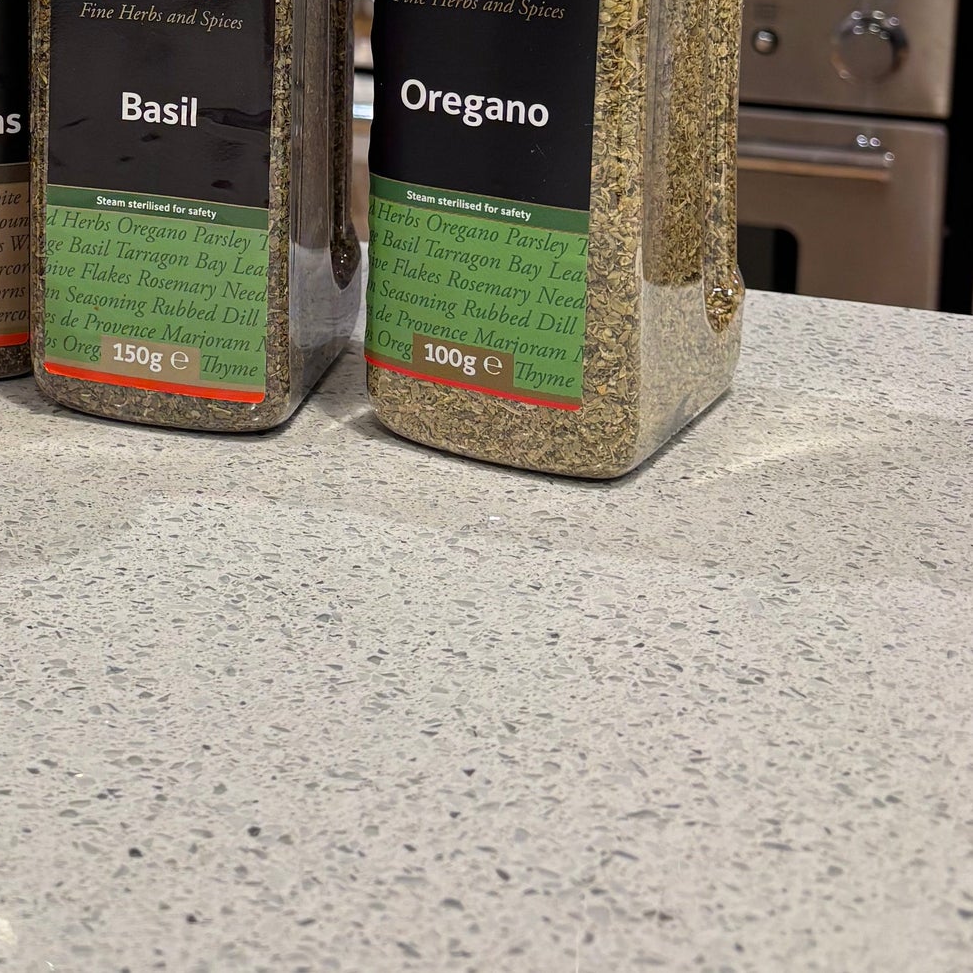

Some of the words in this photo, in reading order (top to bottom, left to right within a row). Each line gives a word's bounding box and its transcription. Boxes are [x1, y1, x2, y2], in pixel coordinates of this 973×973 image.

[79, 2, 114, 19] Fine
[119, 4, 163, 22] Herbs
[167, 9, 197, 25] and
[200, 11, 243, 32] Spices
[121, 91, 198, 127] Basil
[401, 79, 549, 127] Oregano
[96, 196, 125, 208] Steam
[127, 200, 170, 213] sterilised
[173, 204, 185, 214] for
[188, 205, 216, 220] safety
[407, 190, 435, 203] Steam
[438, 197, 481, 211] sterilised
[484, 201, 498, 213] for
[501, 206, 531, 221] safety
[62, 213, 111, 232] Herbs
[117, 217, 187, 242] Oregano
[193, 227, 251, 254] Parsley
[377, 205, 420, 227] Herbs
[427, 214, 499, 242] Oregano
[505, 227, 569, 258] Parsley
[69, 237, 110, 257] Basil
[117, 241, 189, 269] Tarragon
[196, 252, 227, 277] Bay
[382, 230, 419, 253] Basil
[426, 239, 501, 271] Tarragon
[508, 255, 542, 281] Bay
[80, 263, 132, 285] Flakes
[137, 270, 217, 301] Rosemary
[392, 258, 441, 284] Flakes
[446, 270, 531, 306] Rosemary
[66, 286, 147, 317] Seasoning
[151, 297, 218, 322] Rubbed
[222, 306, 258, 327] Dill
[380, 280, 458, 319] Seasoning
[462, 299, 531, 328] Rubbed
[536, 313, 577, 335] Dill
[60, 309, 78, 328] de
[84, 313, 156, 339] Provence
[162, 324, 250, 351] Marjoram
[376, 305, 392, 323] de
[396, 310, 468, 341] Provence
[473, 327, 566, 360] Marjoram
[113, 343, 163, 372] 150g
[202, 355, 258, 379] Thyme
[424, 343, 476, 376] 100g
[515, 361, 575, 388] Thyme
